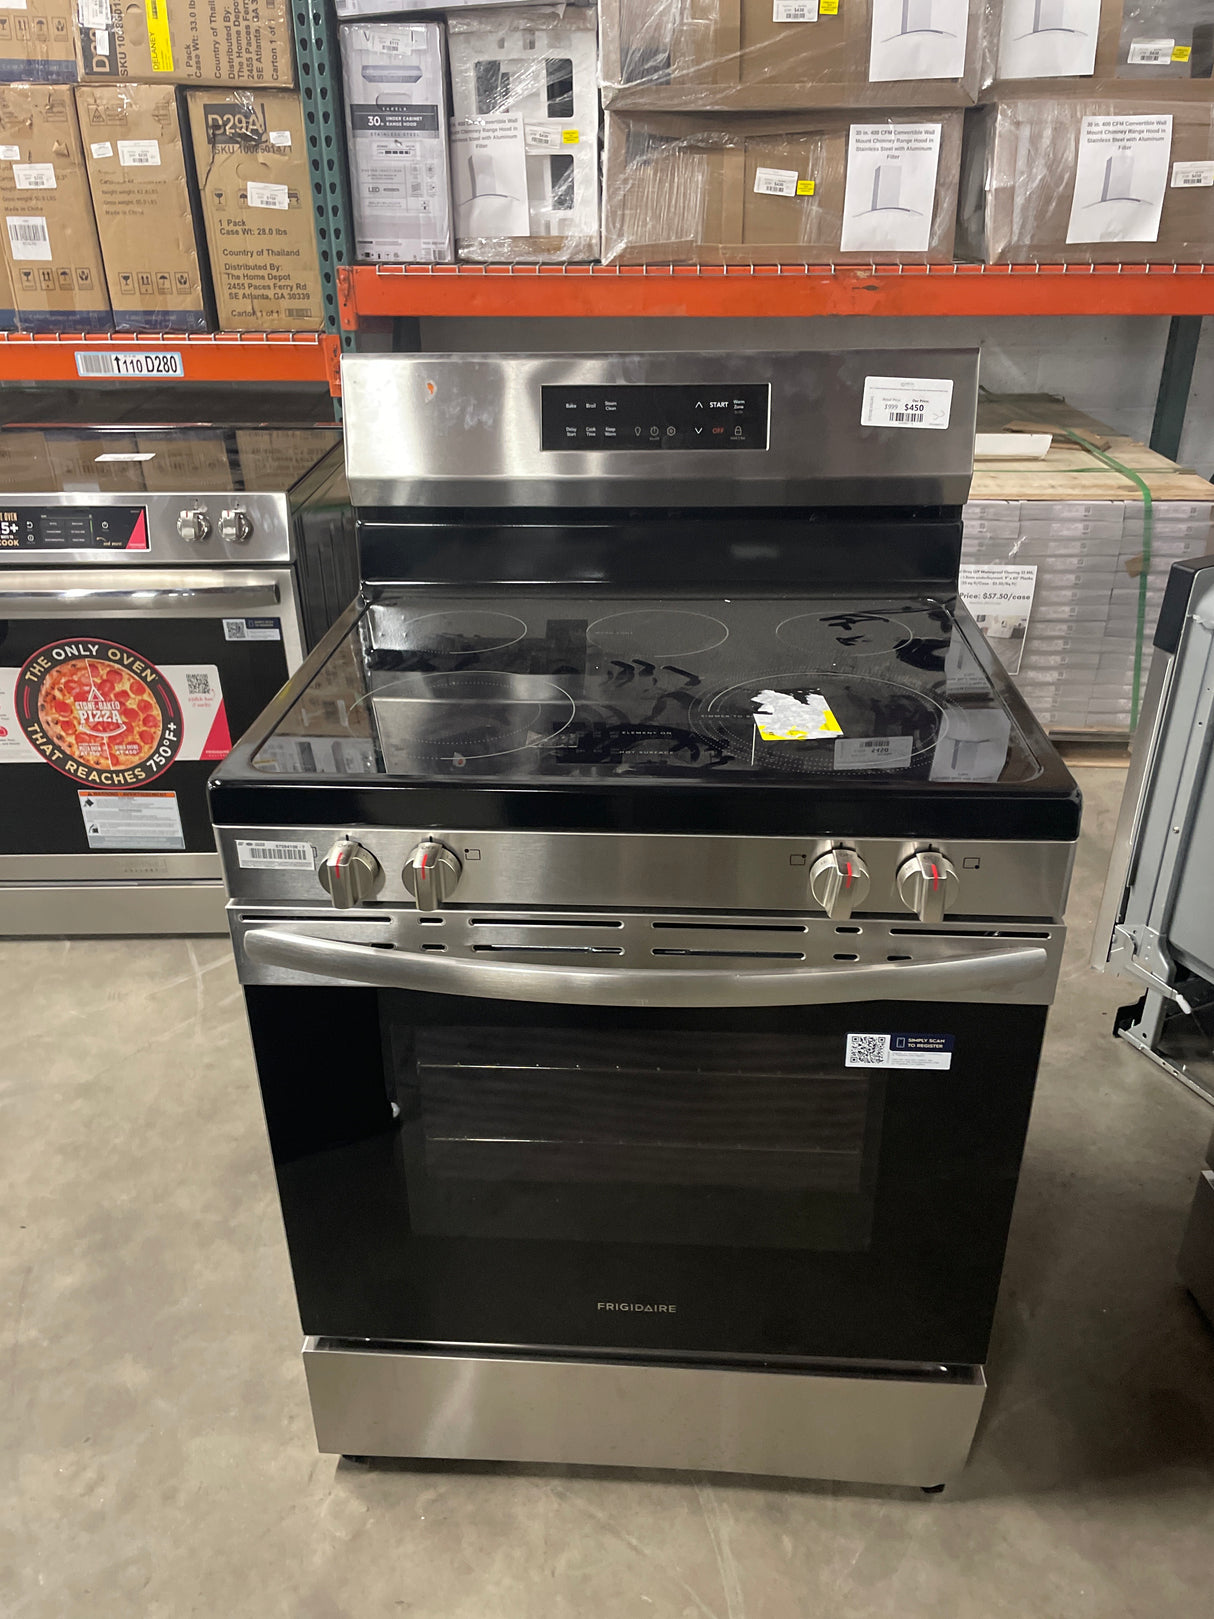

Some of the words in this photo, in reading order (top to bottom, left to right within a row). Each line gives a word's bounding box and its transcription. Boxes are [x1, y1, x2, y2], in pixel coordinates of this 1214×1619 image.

[189, 12, 198, 32] 33.0
[210, 27, 218, 37] of
[244, 24, 253, 54] Paces
[268, 26, 276, 36] of
[235, 30, 244, 58] Home
[184, 44, 193, 68] Pack
[213, 40, 222, 79] Country
[223, 26, 235, 80] Distributed
[117, 52, 128, 77] SKU
[194, 54, 202, 78] Case
[237, 61, 245, 79] The
[245, 57, 255, 80] 2455
[271, 48, 279, 80] Carton
[256, 66, 264, 80] SE
[208, 114, 264, 135] D29A
[214, 145, 235, 154] SKU
[226, 219, 247, 227] Pack
[219, 228, 240, 236] Case
[222, 249, 254, 258] Country
[224, 263, 267, 271] Distributed
[267, 273, 291, 282] Depot
[273, 283, 294, 292] Ferry
[228, 292, 240, 300] SE
[273, 292, 286, 300] GA
[287, 292, 310, 300] 30339
[123, 358, 143, 374] 110
[145, 355, 178, 373] D280
[904, 403, 924, 411] $450
[982, 592, 1031, 601] $57.50/case
[25, 656, 52, 682] THE
[52, 644, 99, 660] ONLY
[78, 710, 122, 724] PIZZA
[28, 724, 63, 761] THAT
[65, 762, 146, 785] REACHES
[147, 722, 177, 772] 750°F+
[597, 1302, 677, 1313] FRIGIDAIRE
